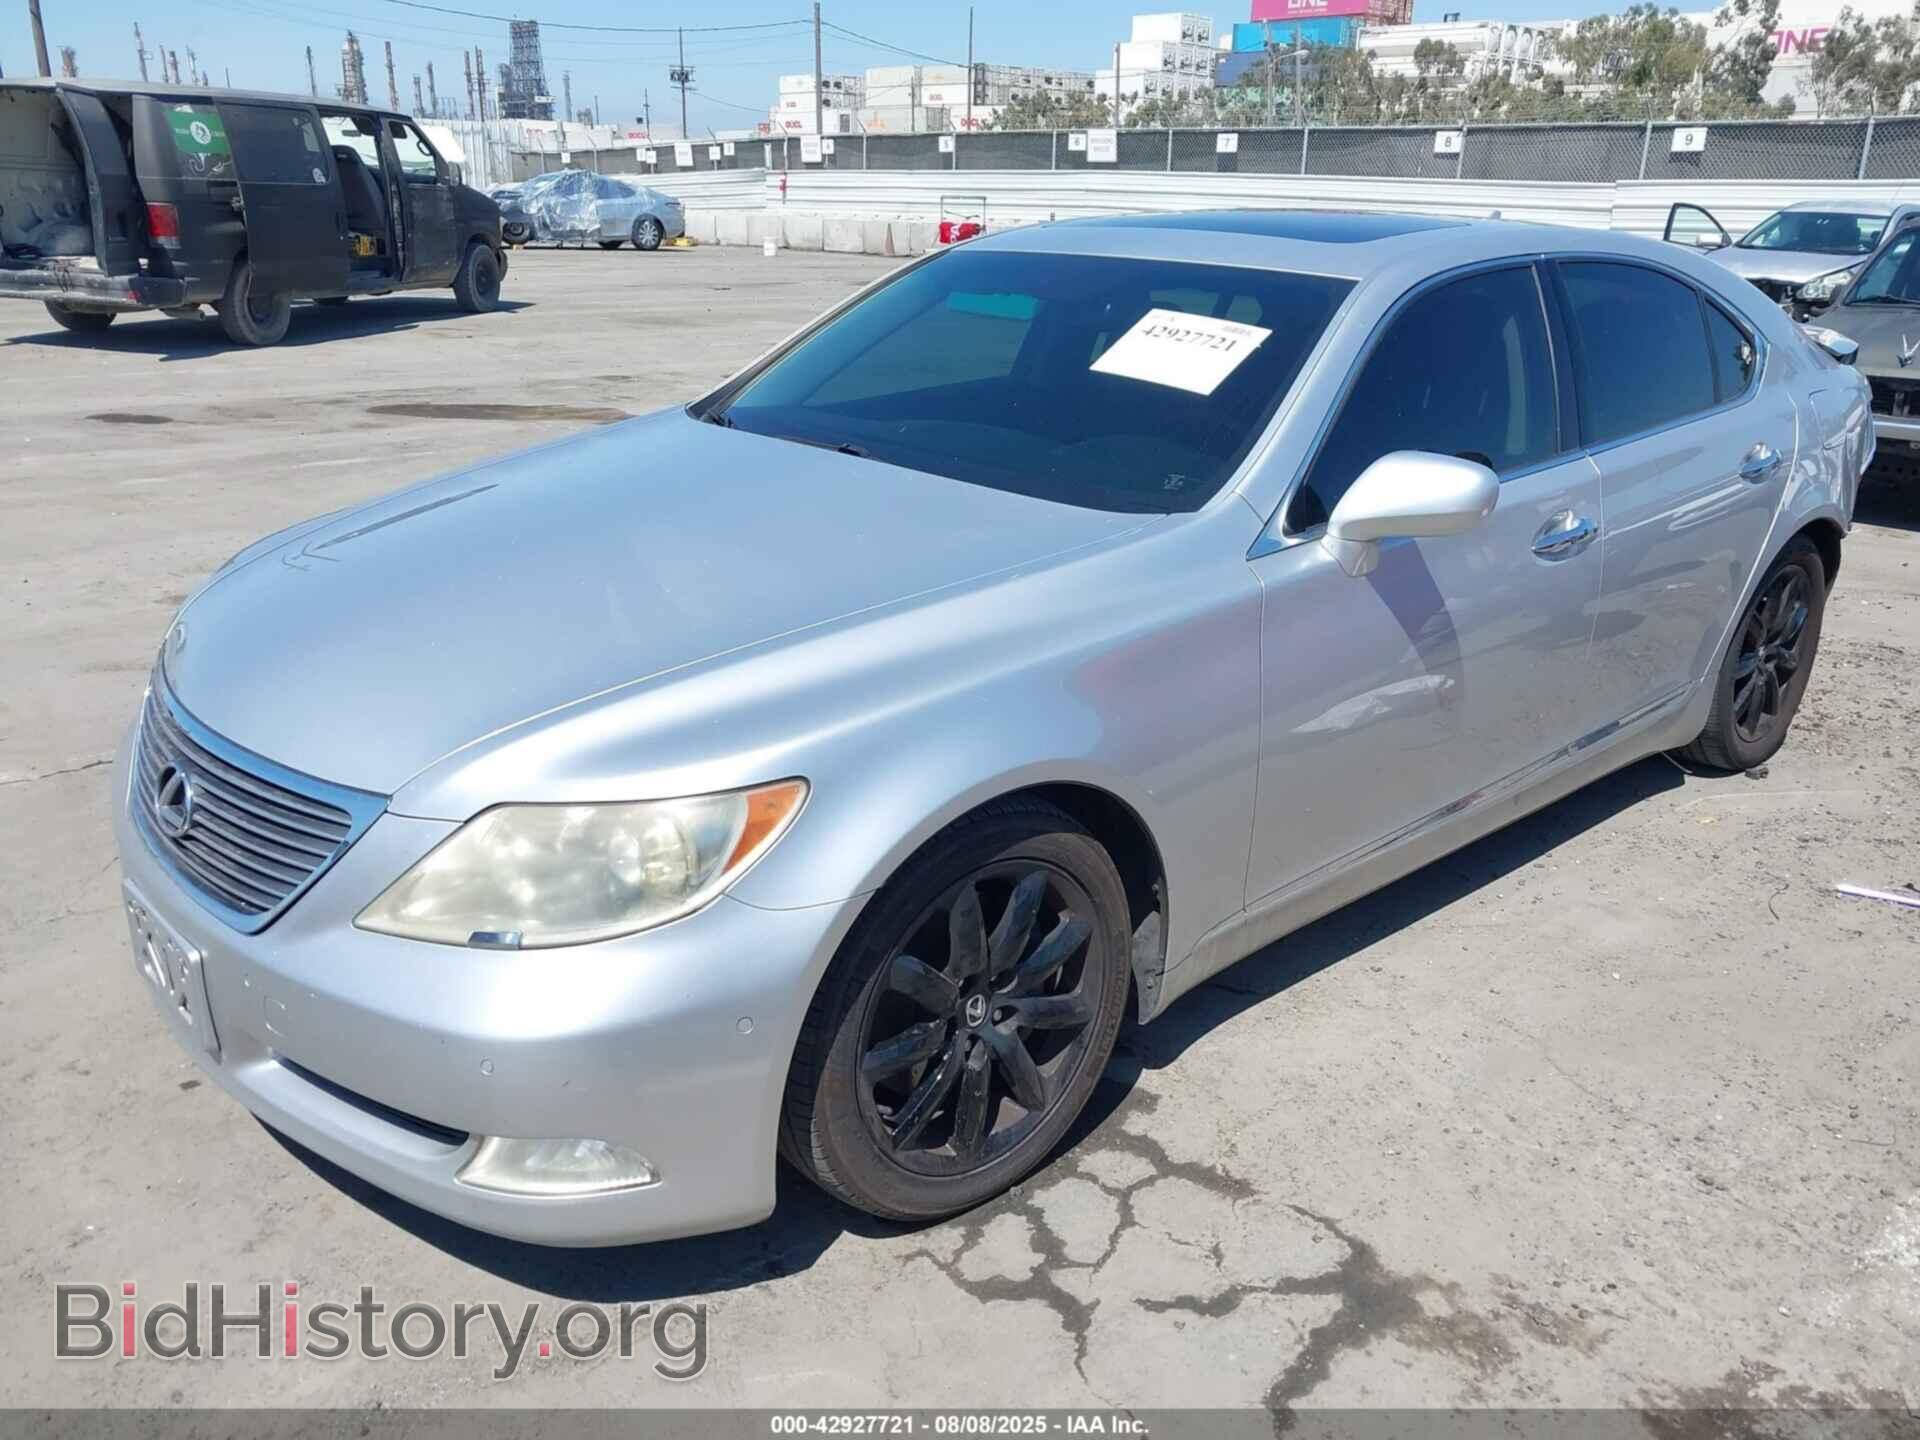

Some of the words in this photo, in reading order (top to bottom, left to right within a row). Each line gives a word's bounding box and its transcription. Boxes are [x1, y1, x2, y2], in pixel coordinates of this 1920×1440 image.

[1223, 137, 1231, 150] 7
[1444, 136, 1452, 148] 8
[1684, 133, 1694, 146] 9
[1142, 324, 1237, 351] 42927721
